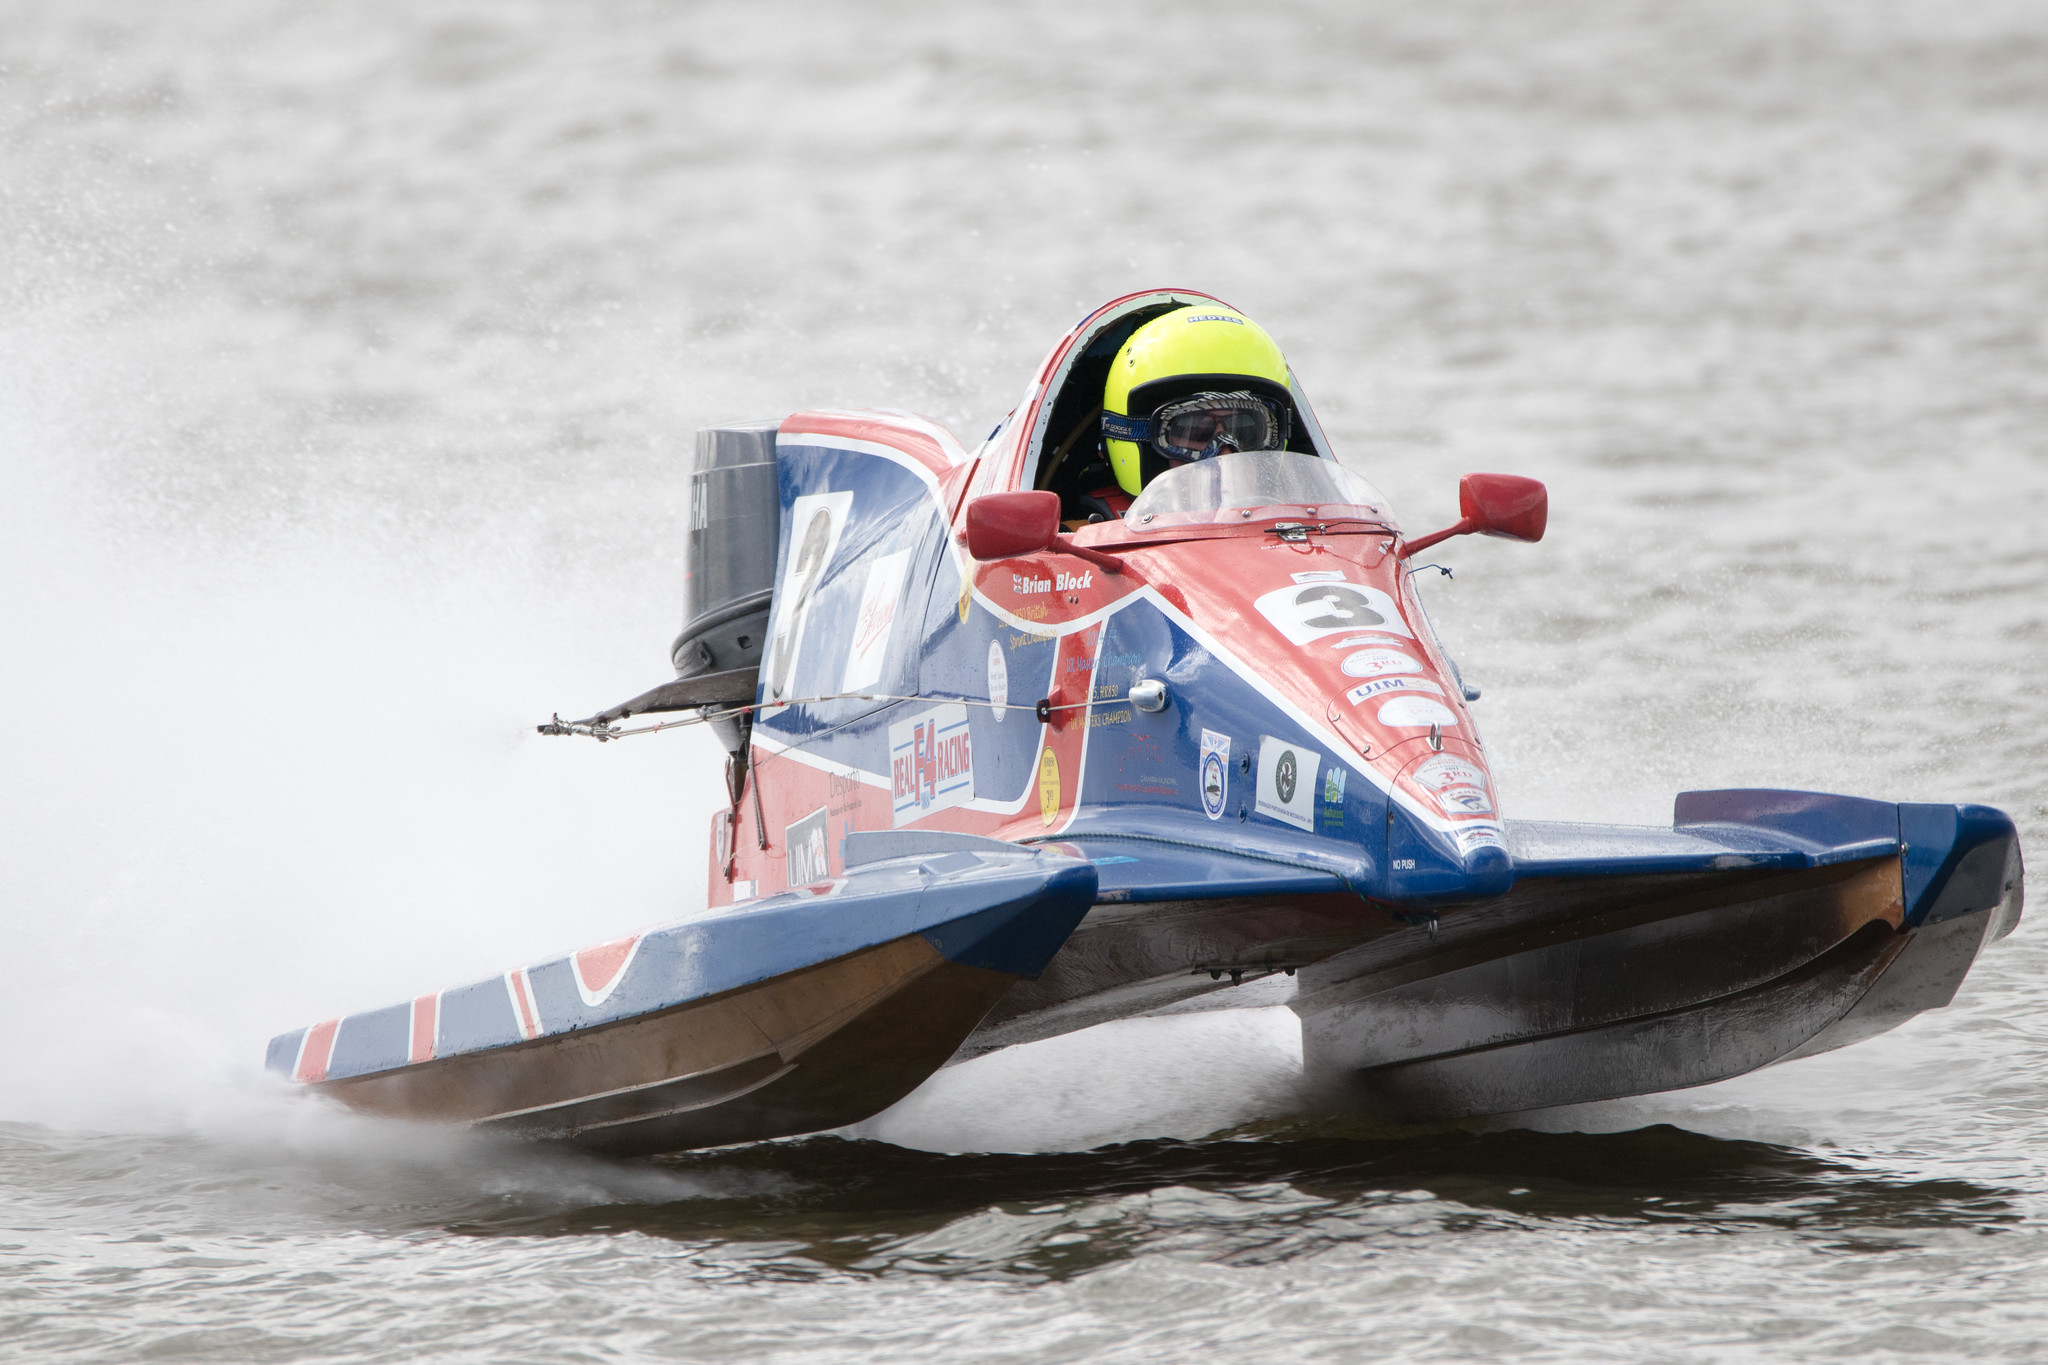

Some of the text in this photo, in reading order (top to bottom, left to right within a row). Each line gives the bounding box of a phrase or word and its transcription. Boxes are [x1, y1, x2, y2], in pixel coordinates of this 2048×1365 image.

[691, 483, 708, 532] HA
[1022, 570, 1093, 594] Brian Block
[1293, 586, 1388, 629] 3
[1099, 684, 1120, 699] HR850
[1101, 710, 1132, 726] CHAMPION
[894, 718, 969, 807] REAL F4 RACING
[829, 768, 861, 802] Desporto
[788, 838, 813, 887] UIM
[1392, 859, 1416, 870] NO PUSH
